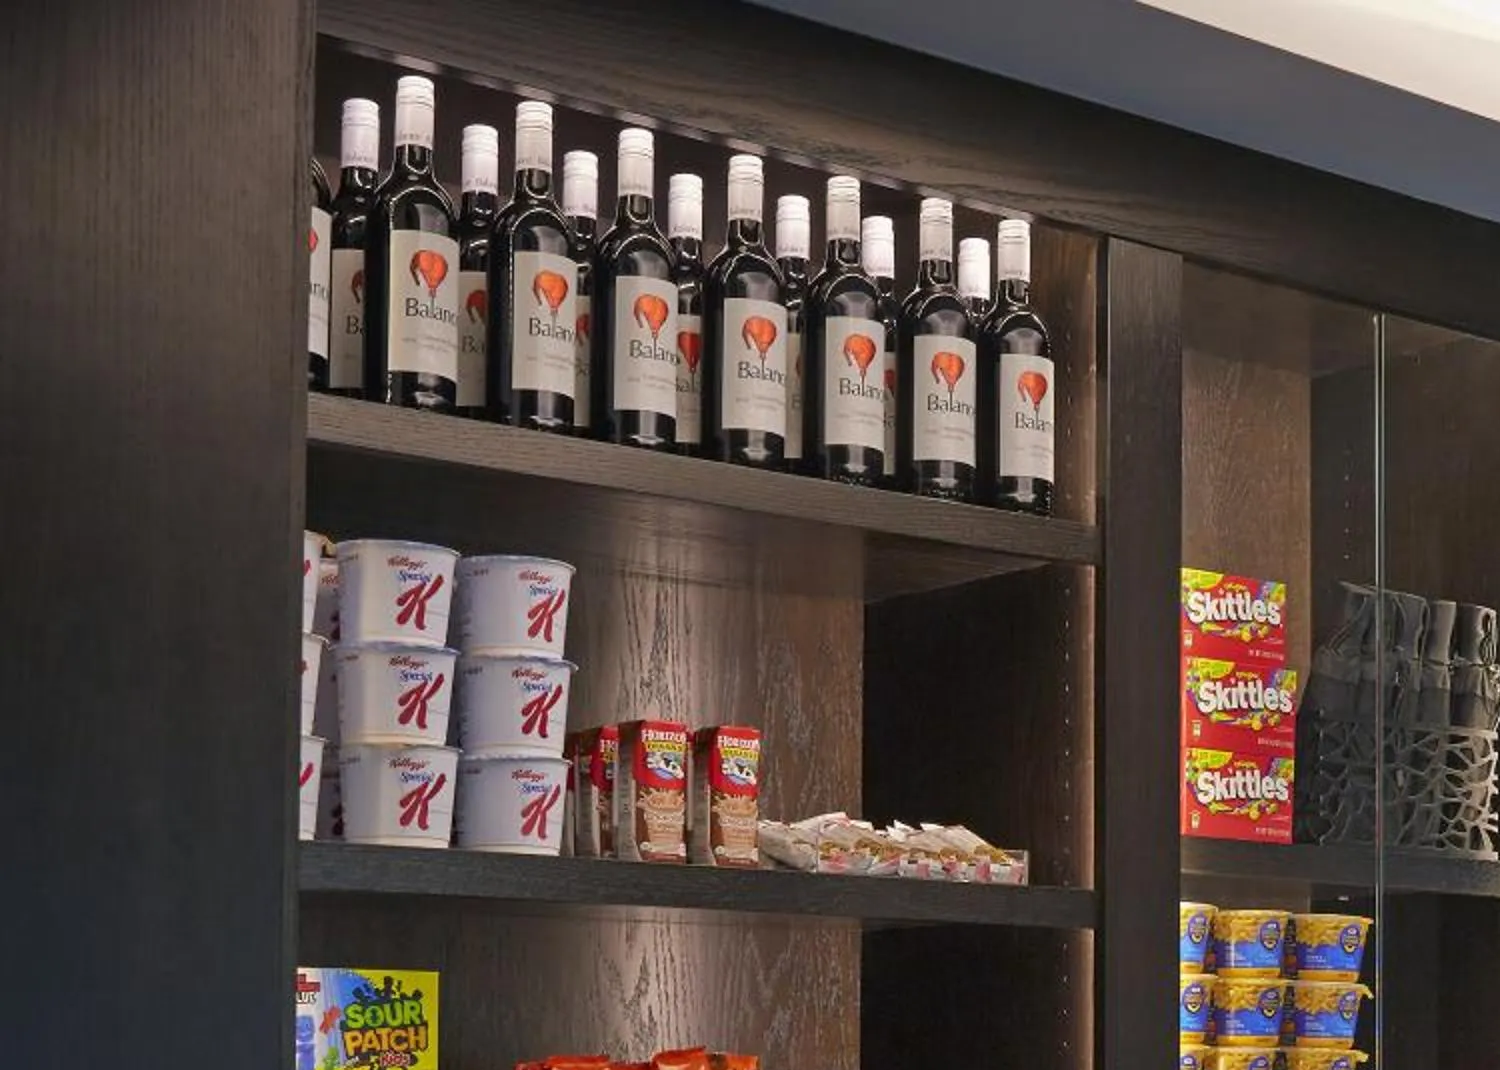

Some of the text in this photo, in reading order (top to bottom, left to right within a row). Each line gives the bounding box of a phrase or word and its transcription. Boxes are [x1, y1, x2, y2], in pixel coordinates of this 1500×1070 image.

[396, 575, 444, 630] K
[527, 590, 565, 642] K
[1188, 590, 1283, 627] Skittles
[398, 673, 444, 729] K
[522, 685, 562, 738] K
[1199, 679, 1294, 713] Skittles
[399, 774, 446, 830] K
[521, 784, 560, 839] K
[1197, 769, 1290, 804] Skittles
[344, 1000, 423, 1028] SOUR
[344, 1024, 428, 1057] PATCH
